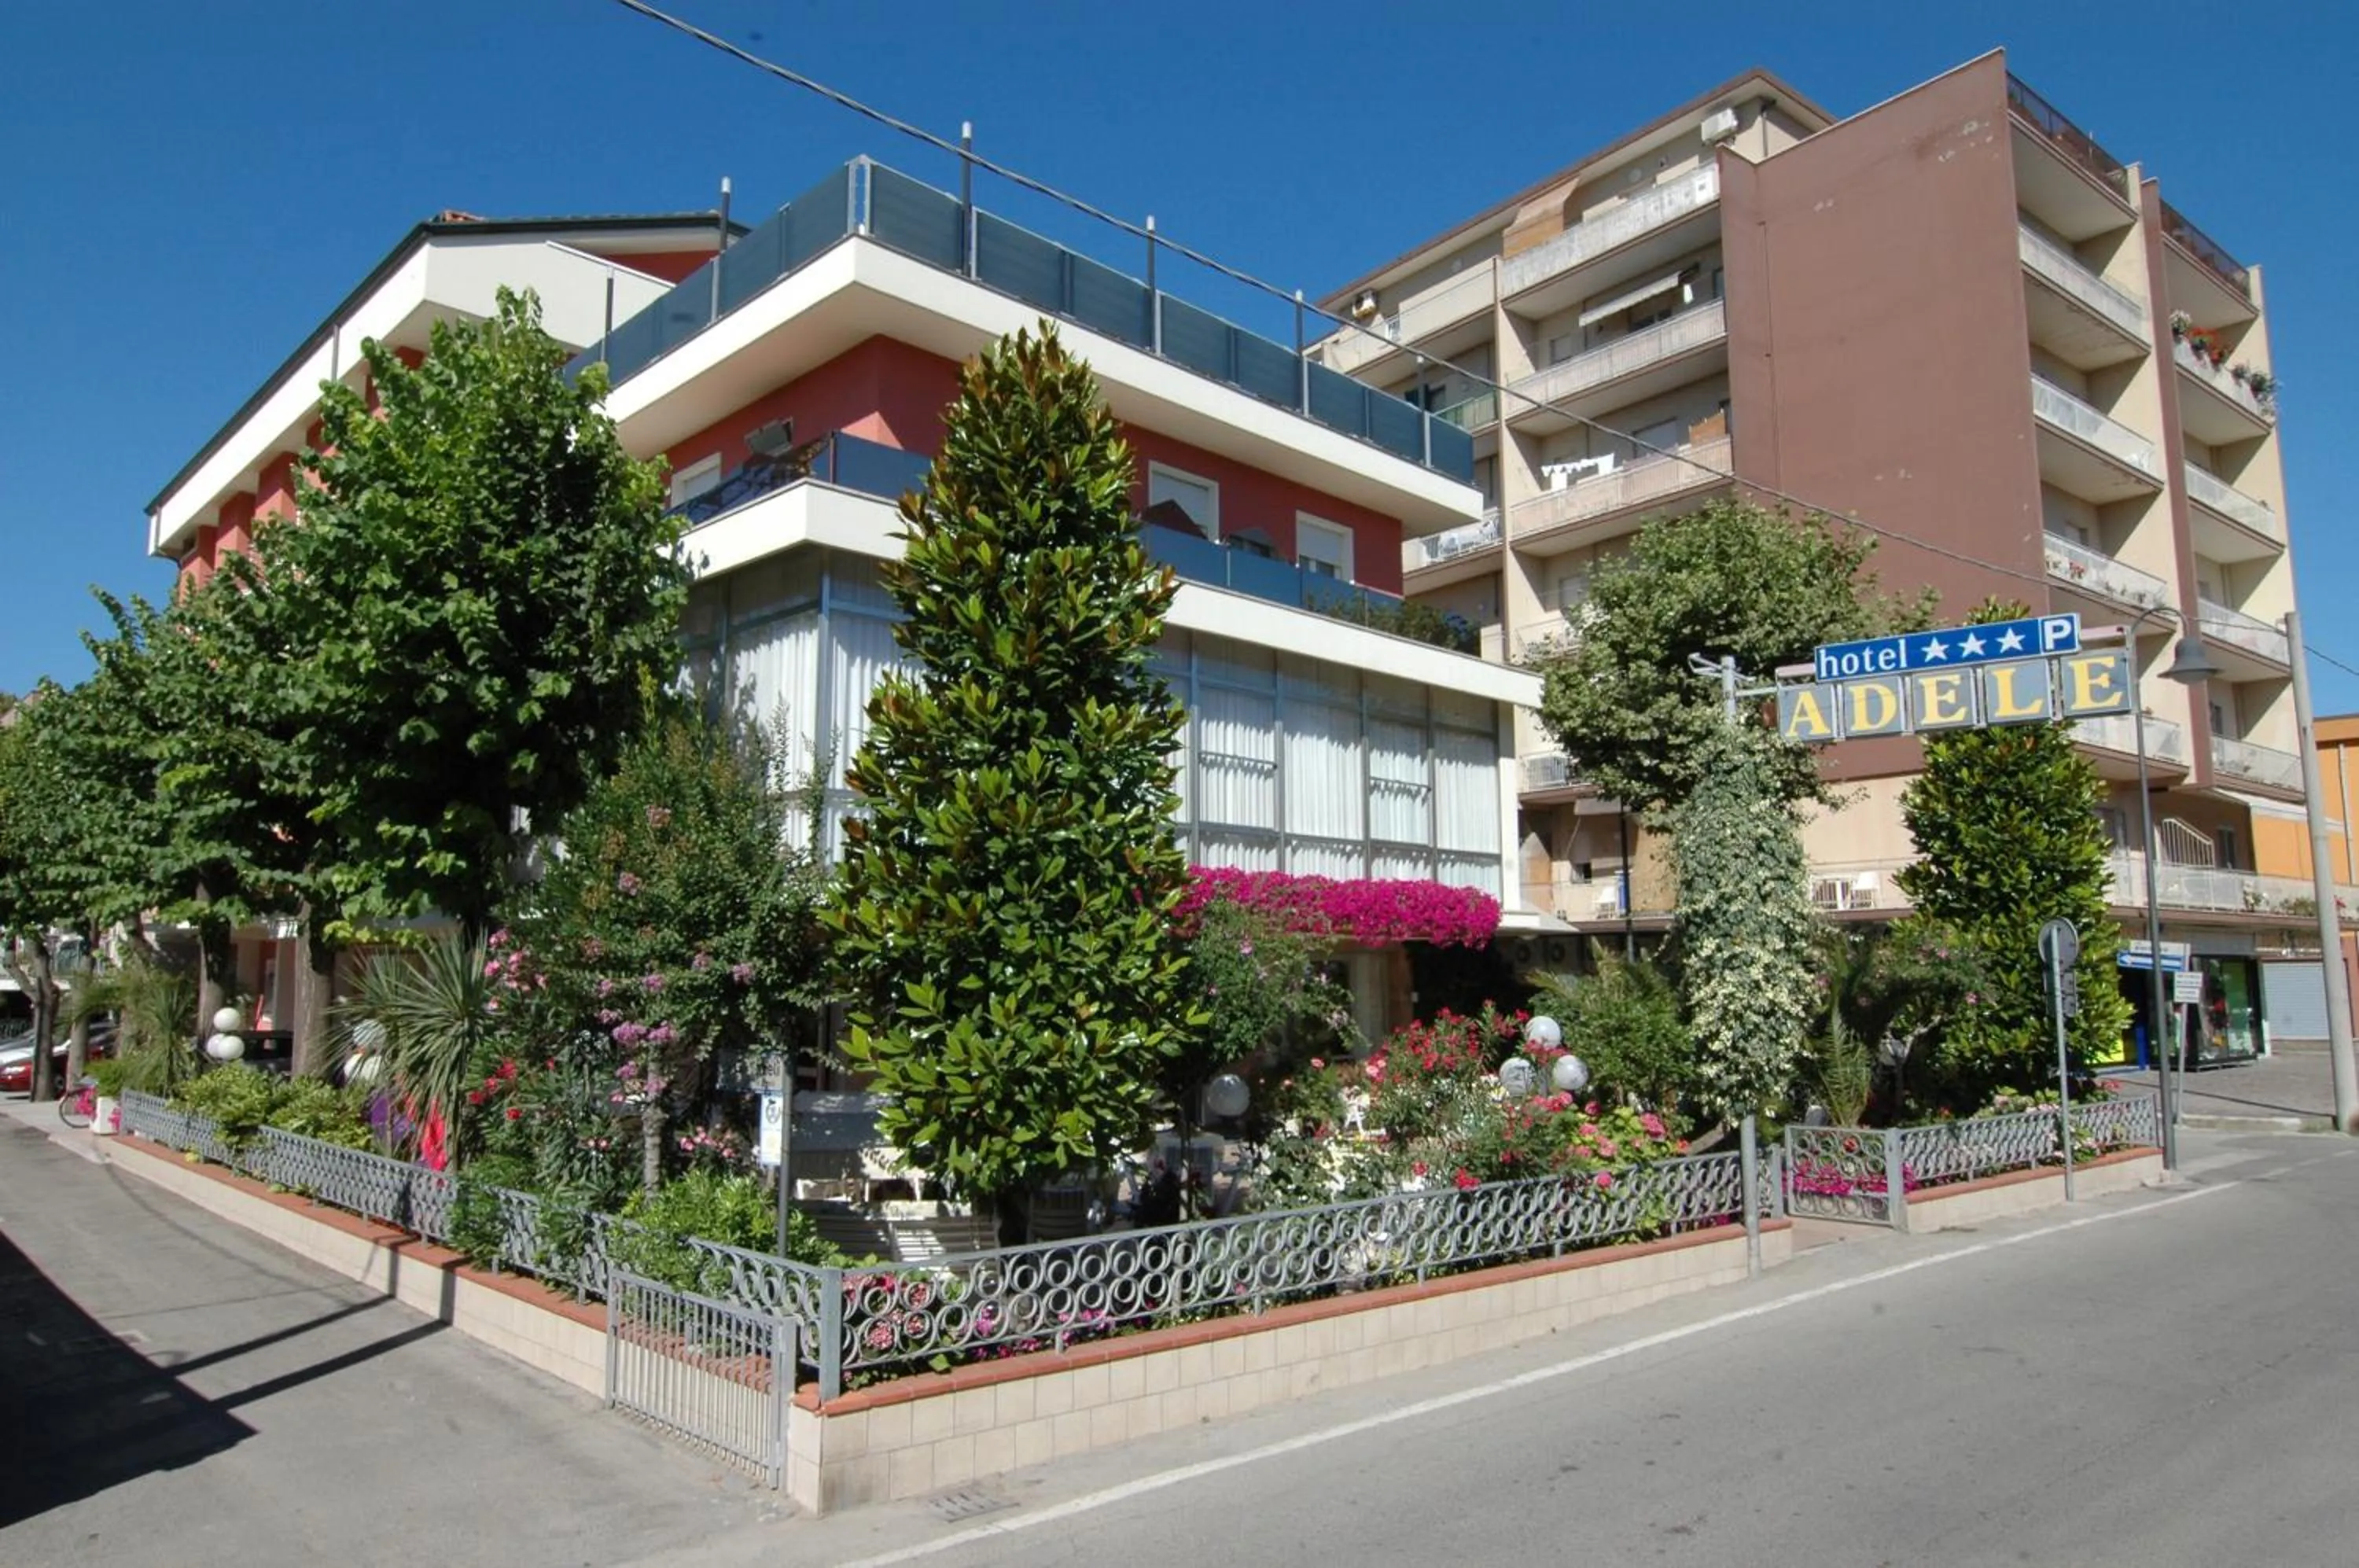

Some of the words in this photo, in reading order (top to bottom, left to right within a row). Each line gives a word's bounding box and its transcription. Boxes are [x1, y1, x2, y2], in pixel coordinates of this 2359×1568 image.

[1819, 639, 1908, 679] hotel
[2044, 619, 2072, 650] P
[1785, 656, 2122, 738] ADELE
